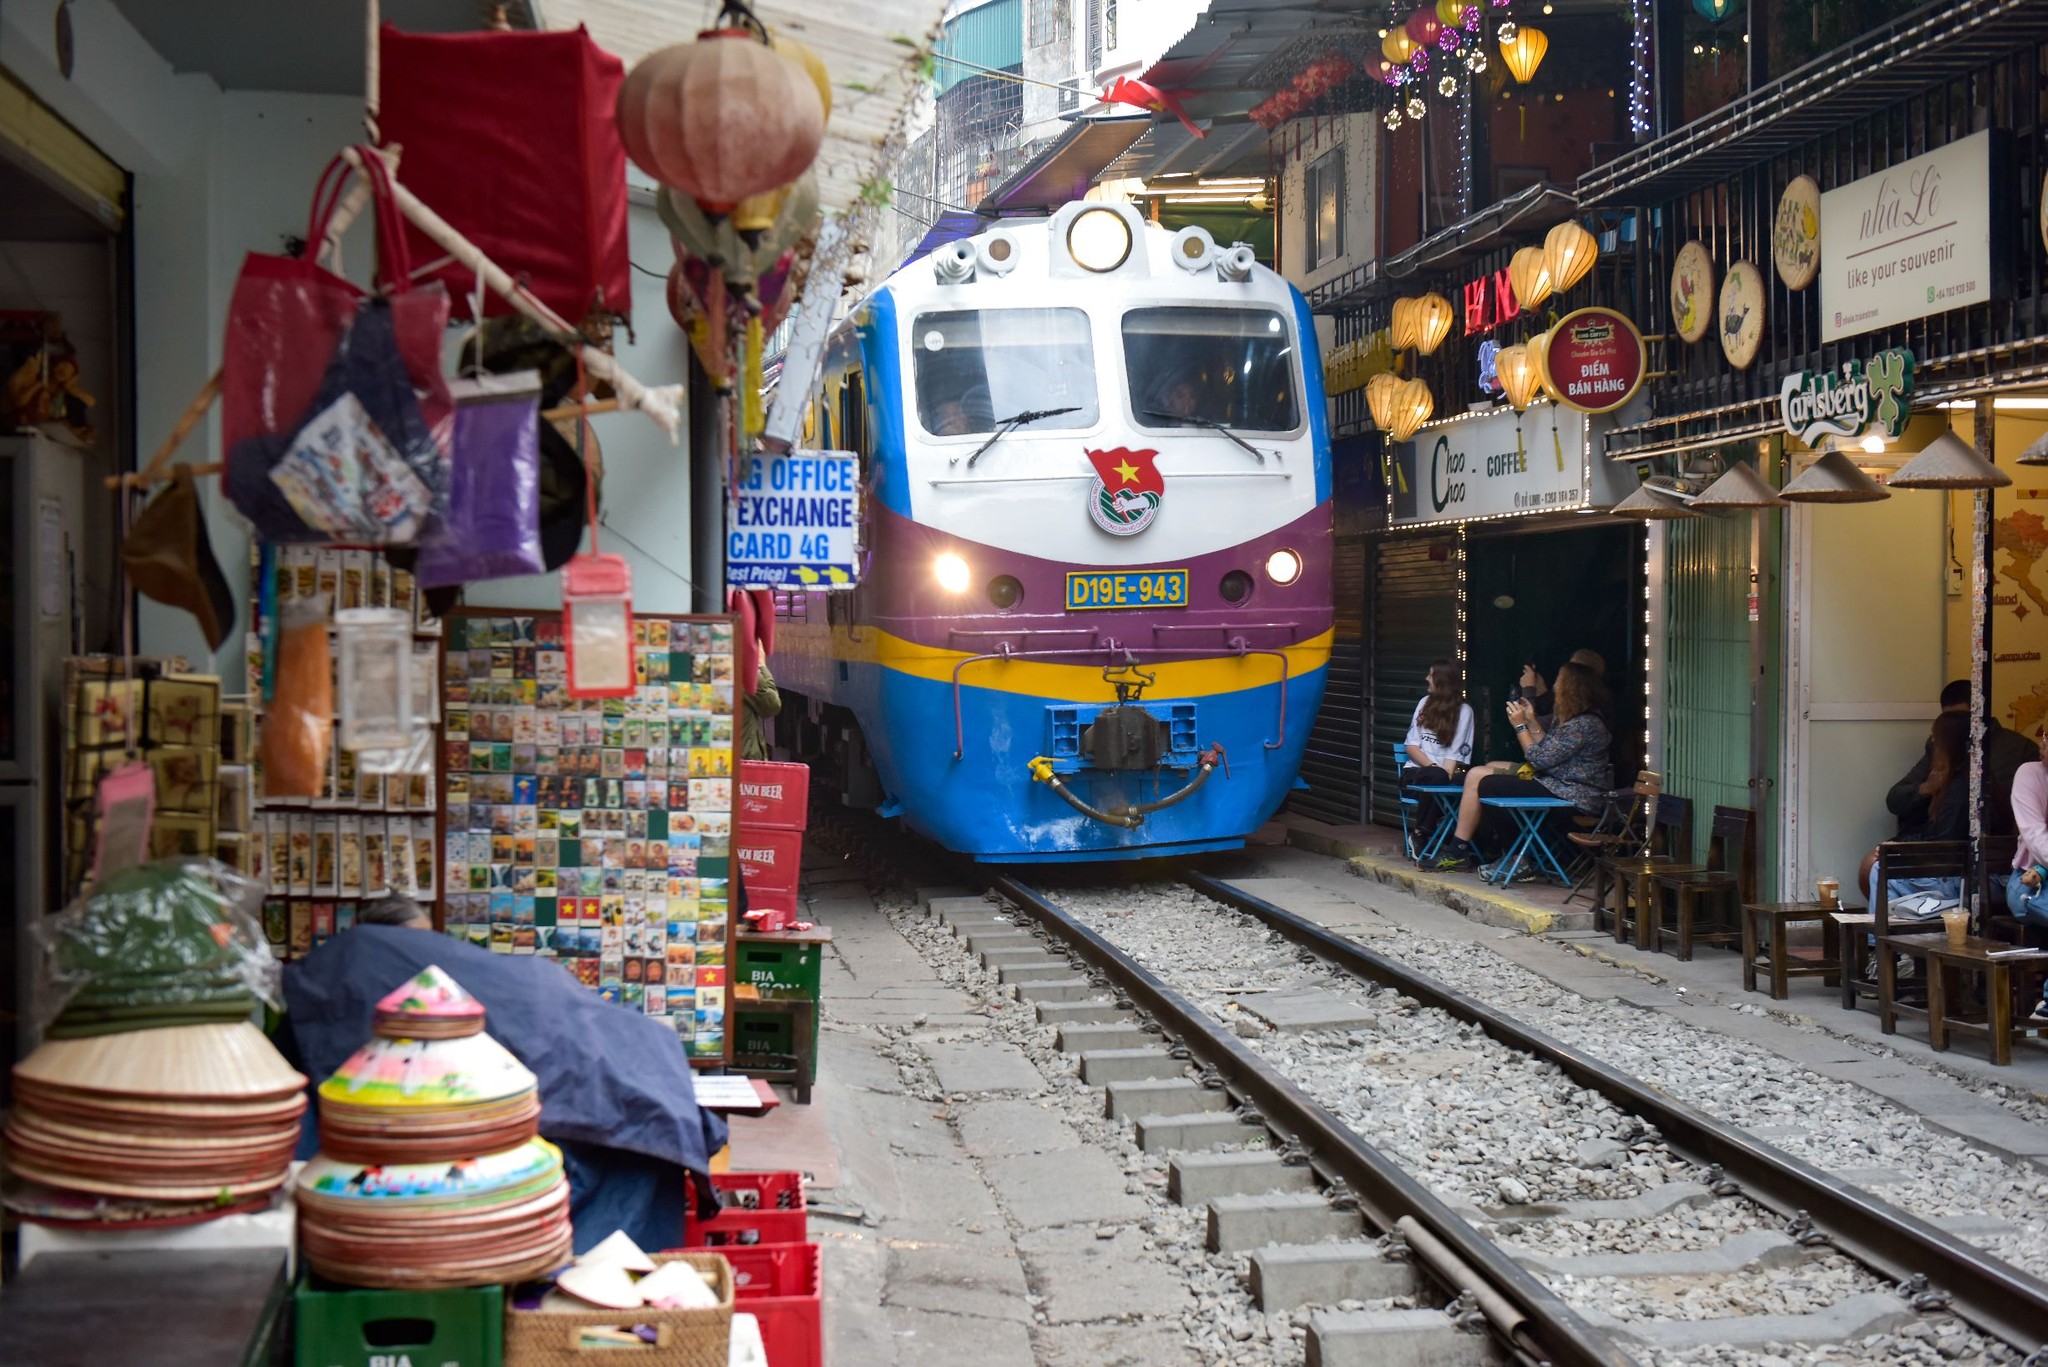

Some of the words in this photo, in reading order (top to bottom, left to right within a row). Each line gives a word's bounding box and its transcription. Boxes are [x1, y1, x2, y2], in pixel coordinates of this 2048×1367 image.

[1847, 268, 1868, 290] like
[1872, 261, 1897, 288] your
[1900, 240, 1955, 274] souvenir
[1568, 380, 1591, 396] BÁN
[1594, 378, 1625, 394] HÀNG
[1781, 364, 1868, 435] Carlsberg
[771, 459, 852, 491] OFFICE
[1487, 450, 1527, 477] COFFEE
[738, 497, 852, 527] EXCHANGE
[729, 532, 791, 559] CARD
[800, 534, 828, 560] 4G
[1073, 575, 1181, 604] D19E-943
[761, 785, 783, 800] BEER
[753, 849, 776, 865] BEER
[751, 970, 775, 982] BIA
